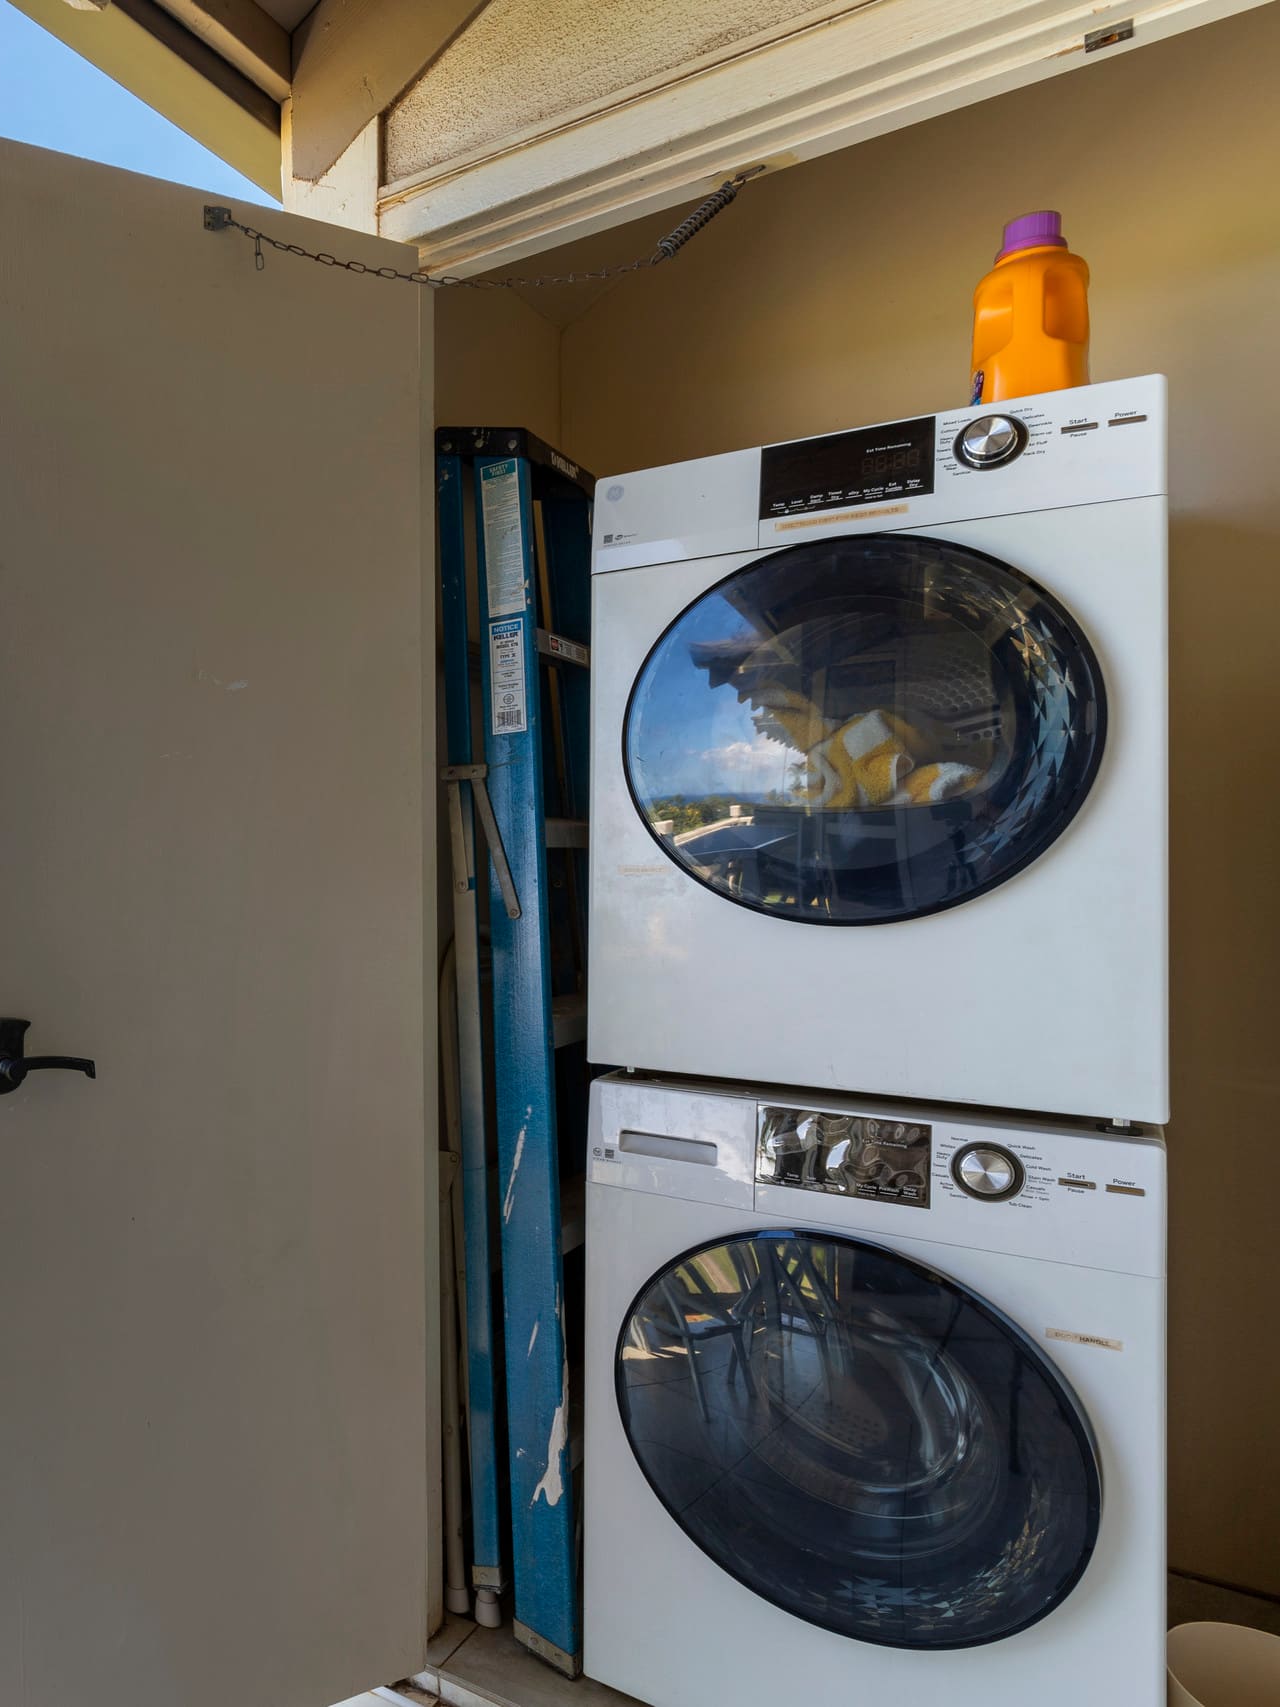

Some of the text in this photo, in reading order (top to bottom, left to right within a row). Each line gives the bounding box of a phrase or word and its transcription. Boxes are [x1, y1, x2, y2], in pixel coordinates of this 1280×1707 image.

[1114, 410, 1137, 418] Power
[1069, 417, 1088, 425] Start
[493, 623, 519, 633] NOTICE
[493, 632, 519, 641] KELLER
[883, 1141, 908, 1149] Remaining
[1067, 1172, 1086, 1180] Start
[1113, 1178, 1136, 1187] Power
